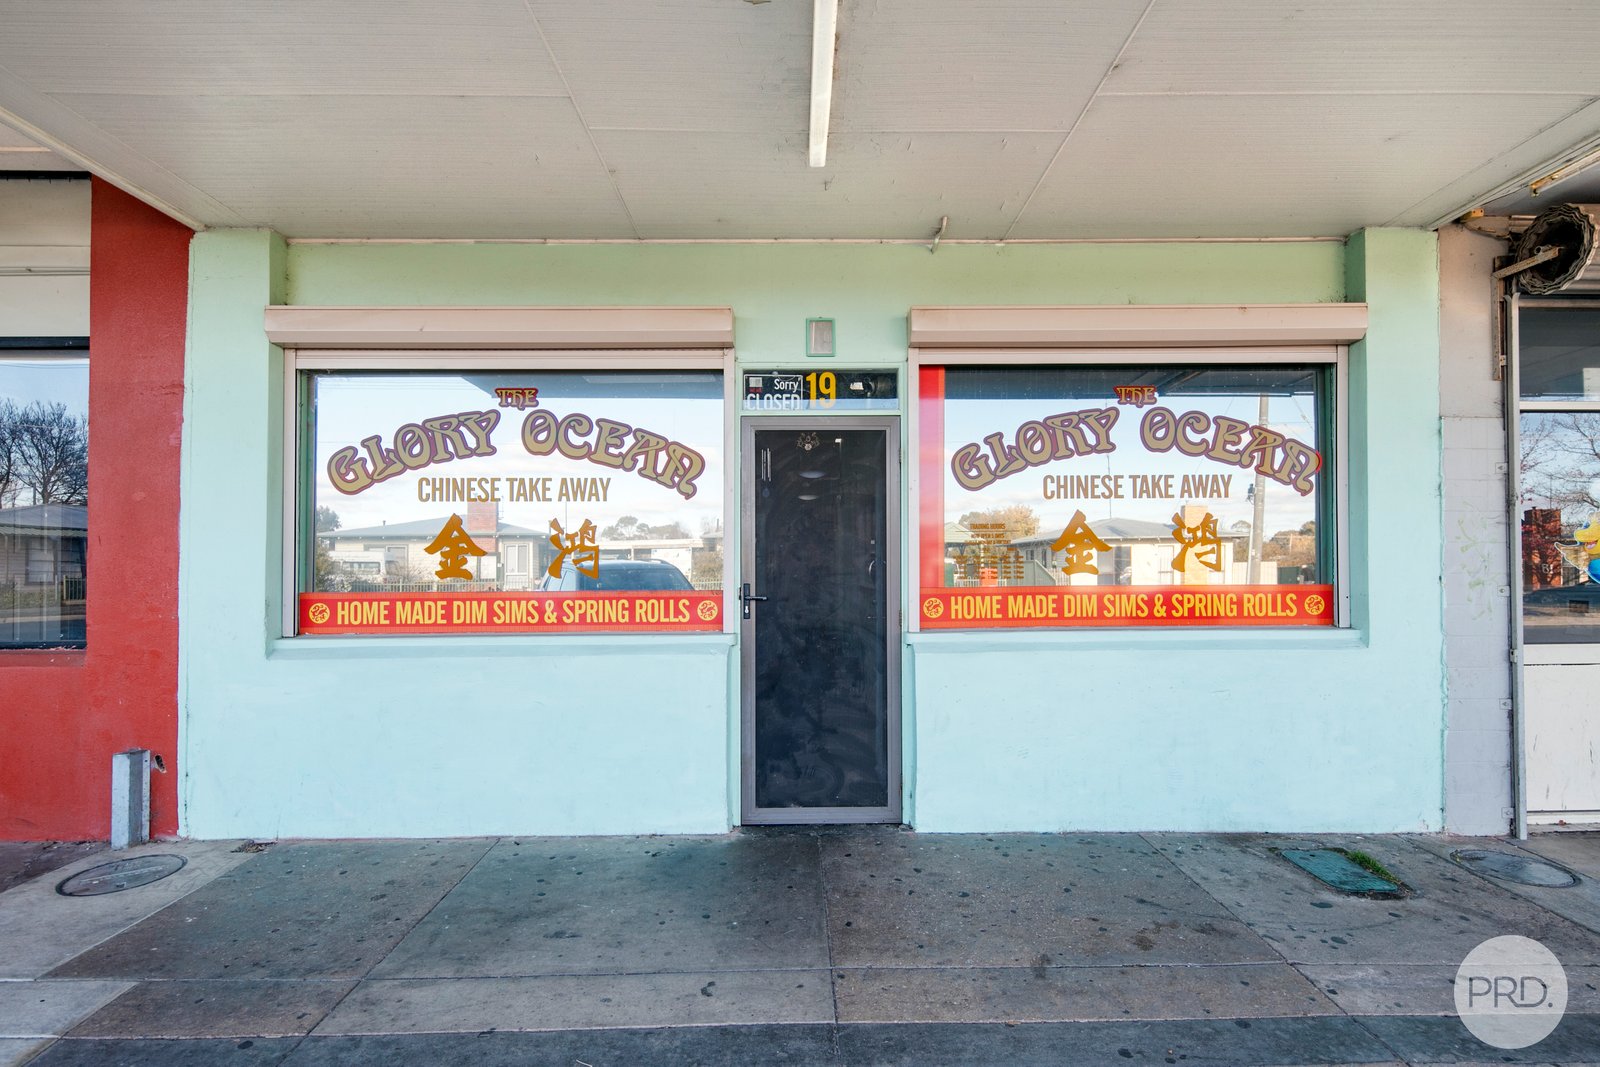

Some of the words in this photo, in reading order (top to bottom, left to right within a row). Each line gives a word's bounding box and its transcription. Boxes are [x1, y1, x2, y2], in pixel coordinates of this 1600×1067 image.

[494, 387, 539, 409] THE
[774, 378, 798, 393] Sorry
[806, 371, 837, 409] 19
[1113, 385, 1158, 408] THE
[746, 393, 800, 410] CLOSED
[328, 410, 500, 496] GLORY
[522, 409, 706, 500] OCEAN
[951, 407, 1120, 491] GLORY
[1140, 406, 1322, 497] OCEAN
[418, 477, 501, 503] CHINESE
[509, 477, 553, 502] TAKE
[557, 477, 611, 502] AWAY
[1043, 474, 1124, 500] CHINESE
[1129, 474, 1175, 499] TAKE
[1180, 474, 1233, 499] AWAY
[424, 513, 487, 579] 金
[1051, 509, 1112, 576] 金
[336, 601, 390, 626] HOME
[396, 601, 448, 626] MADE
[454, 601, 488, 625] DIM
[493, 601, 539, 624] SIMS
[544, 601, 558, 624] &
[562, 600, 632, 624] SPRING
[636, 600, 691, 623] ROLLS
[950, 594, 1003, 620] HOME
[1008, 594, 1059, 619] MADE
[1063, 594, 1098, 619] DIM
[1104, 594, 1149, 618] SIMS
[1153, 594, 1167, 617] &
[1171, 593, 1239, 617] SPRING
[1243, 593, 1298, 617] ROLLS
